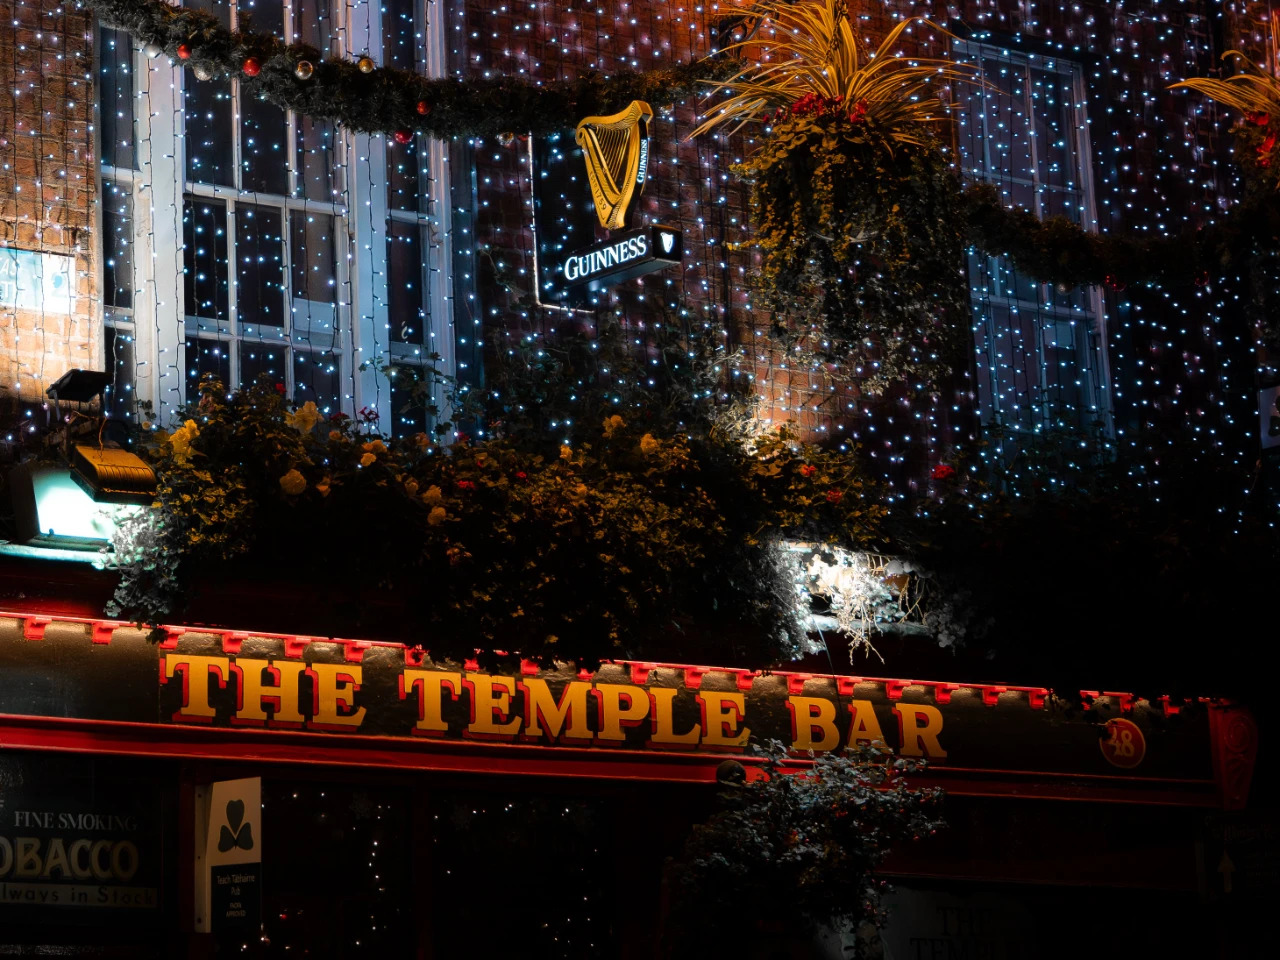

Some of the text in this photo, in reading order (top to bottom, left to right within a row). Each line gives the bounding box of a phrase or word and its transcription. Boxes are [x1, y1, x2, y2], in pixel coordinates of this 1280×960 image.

[636, 139, 649, 183] GUINNESS
[564, 235, 648, 280] GUINNESS
[163, 653, 949, 758] THE TEMPLE BAR
[1106, 726, 1135, 757] 48
[14, 810, 137, 832] FINE SMOKING
[71, 886, 89, 903] in
[97, 887, 154, 906] Stock
